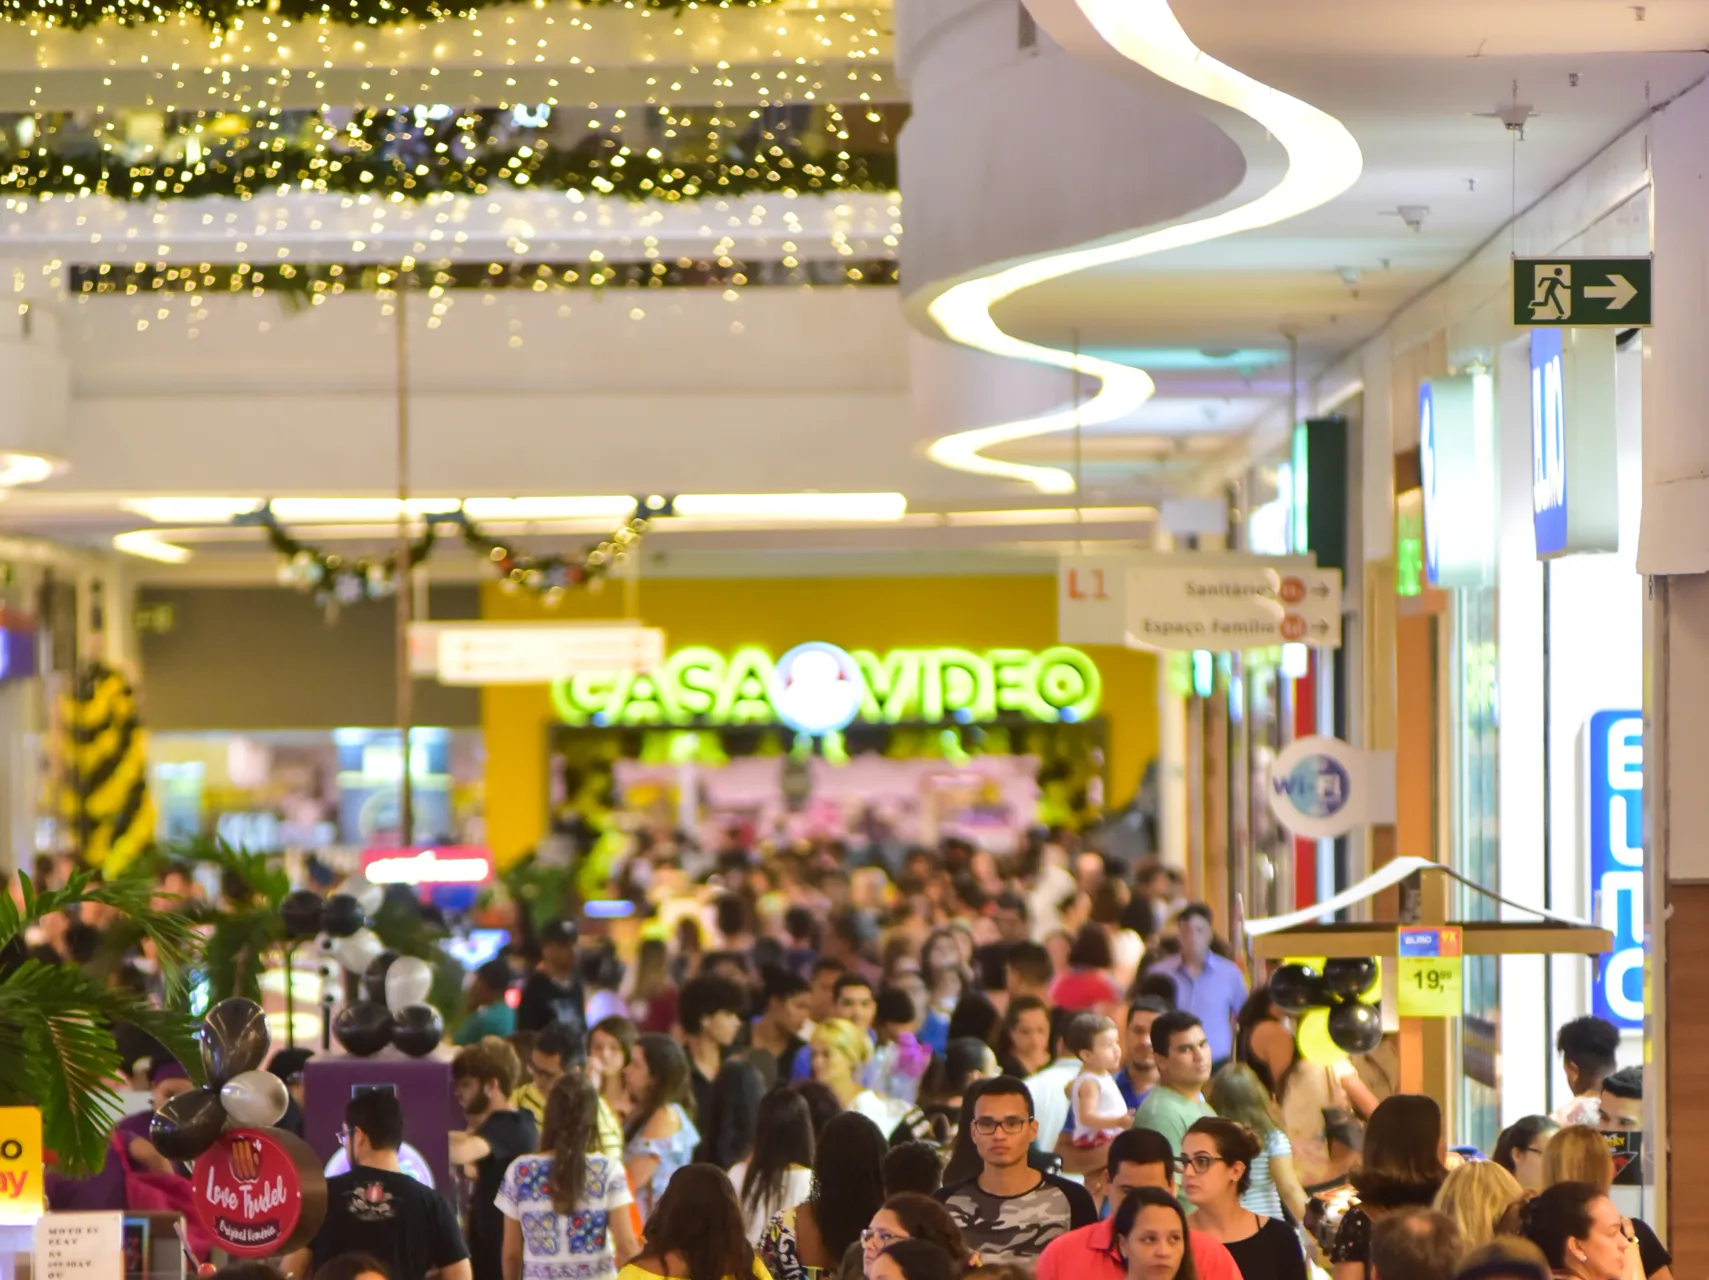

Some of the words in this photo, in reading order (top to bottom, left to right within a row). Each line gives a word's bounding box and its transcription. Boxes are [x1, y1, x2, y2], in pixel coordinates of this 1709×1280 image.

[1067, 568, 1108, 600] L1
[1143, 617, 1204, 637] Espaço
[551, 646, 776, 725] CASA
[855, 646, 1102, 724] VIDEO
[206, 1165, 239, 1210] Love
[238, 1174, 287, 1219] Trudel
